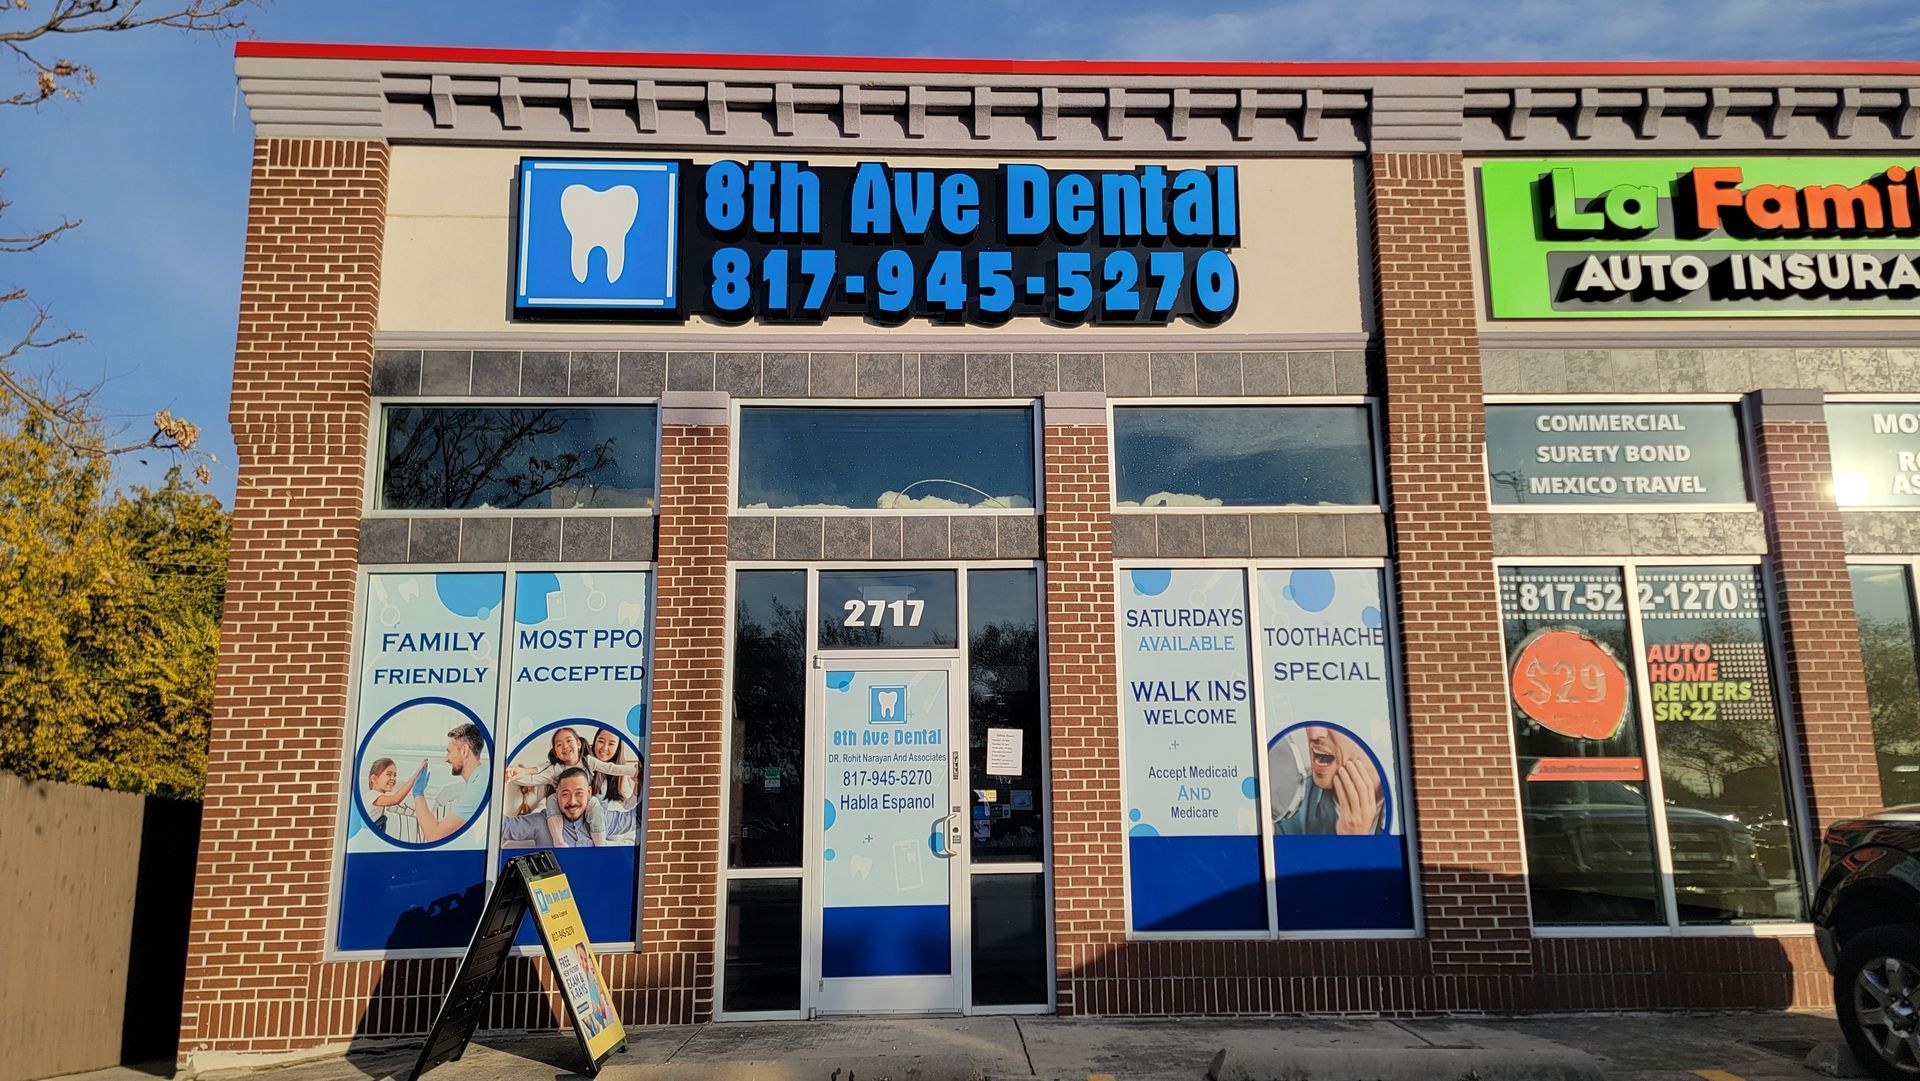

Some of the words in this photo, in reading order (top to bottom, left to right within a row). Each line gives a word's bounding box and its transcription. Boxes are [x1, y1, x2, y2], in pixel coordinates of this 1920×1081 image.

[704, 159, 821, 234] 8th
[849, 162, 981, 235] Ave
[1006, 163, 1238, 236] Dental
[1551, 166, 1660, 230] La
[711, 248, 1236, 312] 817-945-5270
[1575, 254, 1710, 292] AUTO
[1730, 252, 1920, 290] INSURA
[1535, 413, 1686, 432] COMMERCIAL
[1872, 413, 1920, 434] MO
[1535, 444, 1620, 463] SURETY
[1625, 444, 1692, 462] BOND
[1898, 451, 1920, 472] R
[1529, 477, 1618, 495] MEXICO
[1621, 475, 1707, 494] TRAVEL
[843, 599, 925, 627] 2717
[1126, 608, 1244, 628] SATURDAYS
[382, 631, 486, 653] FAMILY
[519, 629, 588, 650] MOST
[593, 628, 643, 649] PPO
[1138, 635, 1236, 652] AVAILABLE
[1263, 627, 1384, 647] TOOTHACHE
[1647, 643, 1711, 663] AUTO
[373, 667, 489, 685] FRIENDLY
[516, 665, 646, 683] ACCEPTED
[1273, 661, 1381, 682] SPECIAL
[1650, 663, 1719, 682] HOME
[1130, 680, 1202, 702] WALK
[1207, 679, 1248, 702] INS
[1653, 681, 1753, 702] RENTERS
[1143, 709, 1237, 725] WELCOME
[1655, 701, 1718, 721] SR-22
[833, 730, 857, 746] 8th
[862, 730, 889, 746] Ave
[894, 728, 942, 745] Dental
[828, 754, 841, 763] DR.
[843, 753, 861, 763] Rohit
[862, 753, 892, 765] Narayan
[893, 752, 907, 762] And
[909, 752, 947, 762] Associates
[843, 769, 932, 787] 817-945-5270
[1148, 765, 1187, 780] Accept
[1189, 765, 1238, 779] Medicaid
[1178, 784, 1212, 801] AND
[840, 794, 878, 811] Habla
[882, 793, 935, 814] Espanol
[1171, 806, 1219, 819] Medicare
